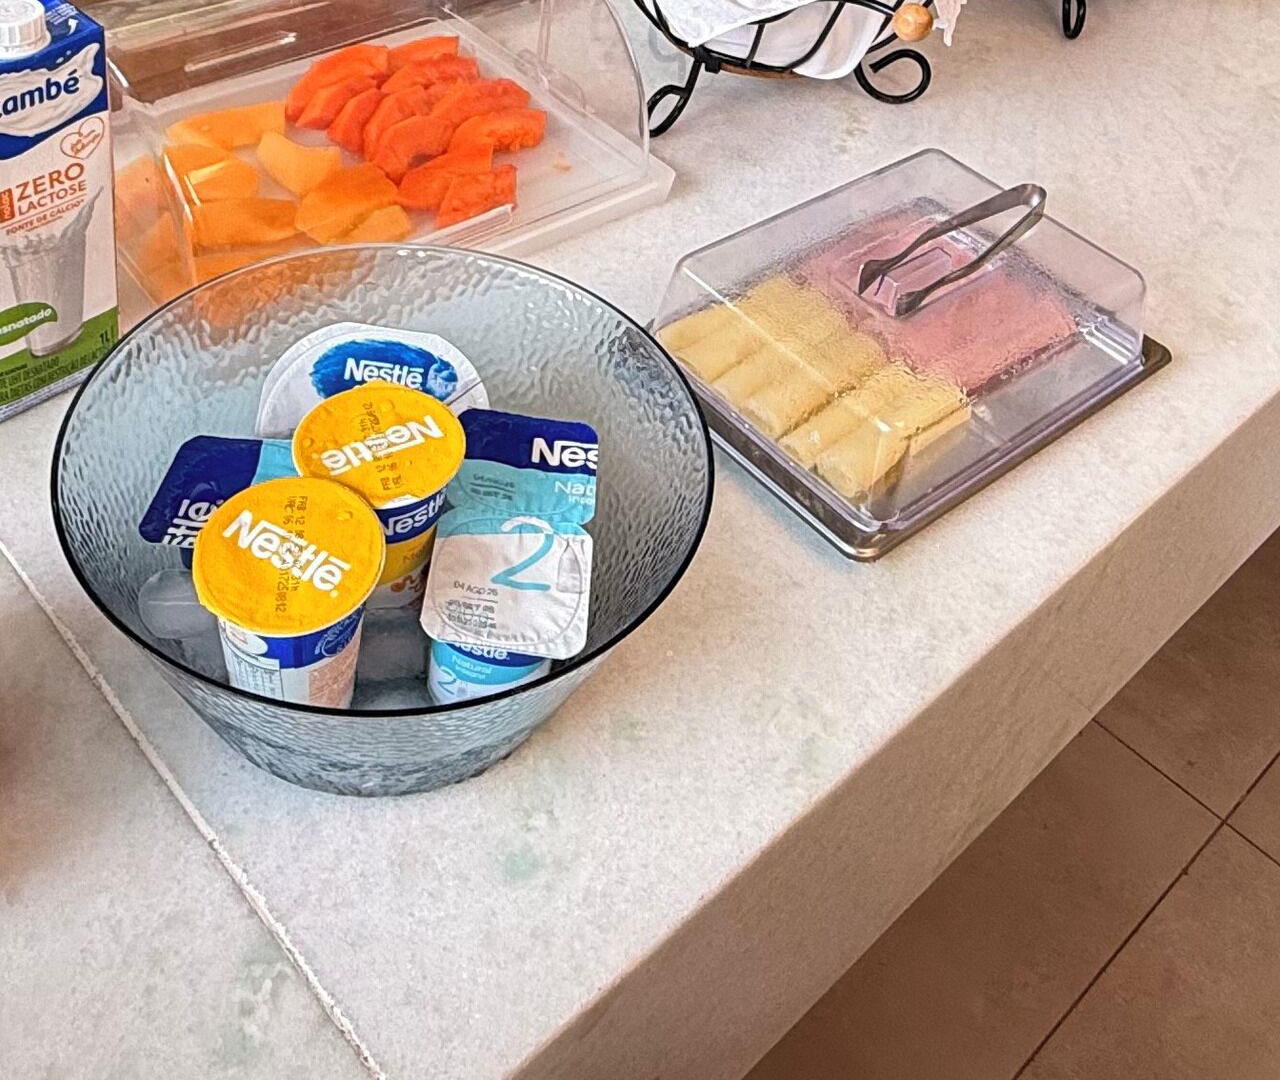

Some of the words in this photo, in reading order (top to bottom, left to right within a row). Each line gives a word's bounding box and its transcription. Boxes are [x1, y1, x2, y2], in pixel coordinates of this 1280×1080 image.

[15, 162, 85, 202] ZERO
[18, 180, 87, 216] LACTOSE
[344, 357, 425, 389] Nestlé
[320, 415, 445, 476] Nestlé
[222, 509, 352, 592] Nestlé
[490, 515, 555, 591] 2
[452, 655, 493, 675] Natural
